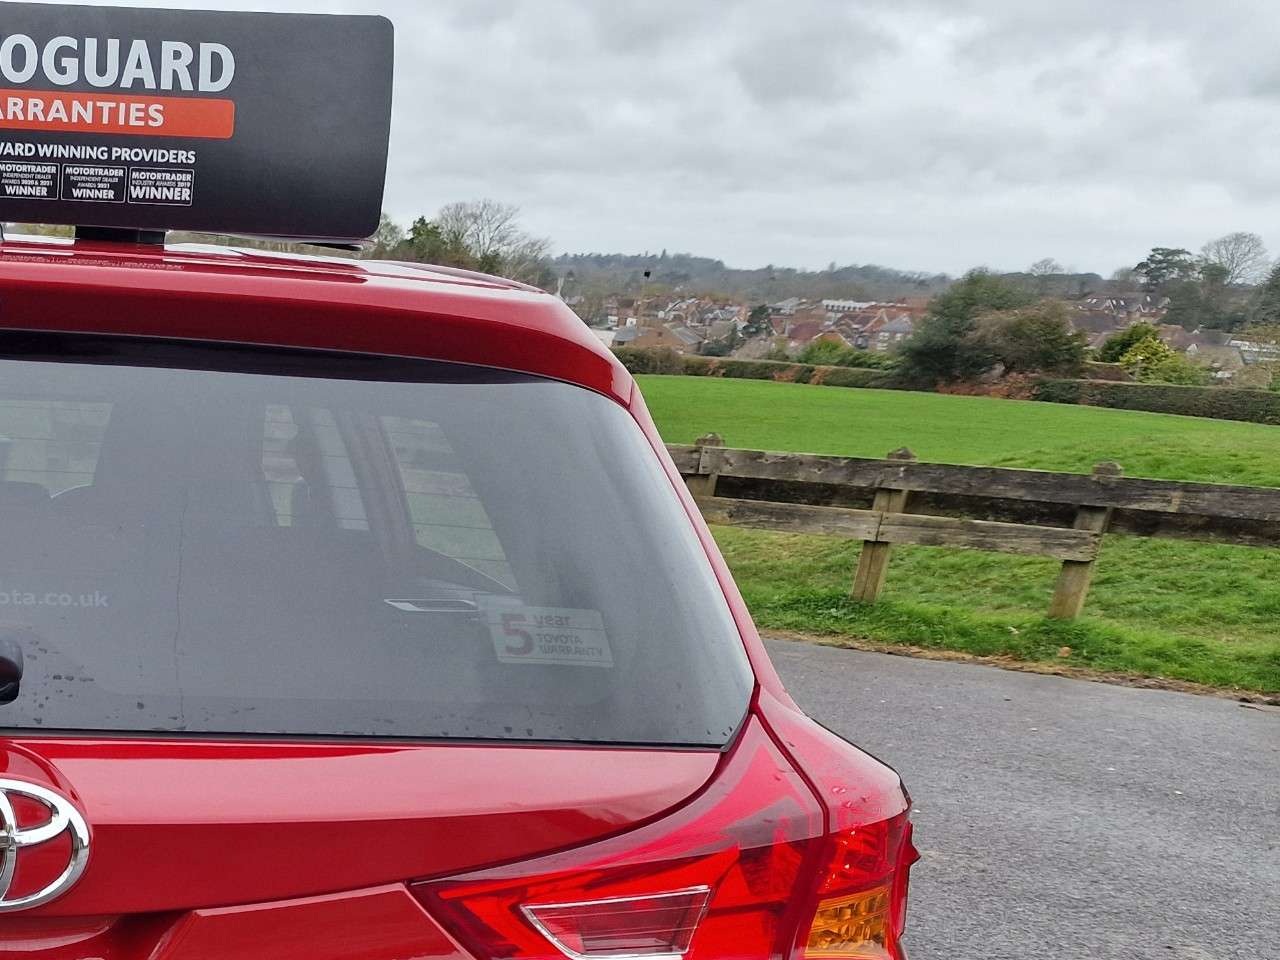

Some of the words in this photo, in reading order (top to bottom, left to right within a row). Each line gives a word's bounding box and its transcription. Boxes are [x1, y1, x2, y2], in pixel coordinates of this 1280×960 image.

[36, 144, 108, 161] WINNING
[111, 147, 197, 164] PROVIDERS
[65, 166, 124, 177] MOTORTRADER
[131, 171, 192, 182] MOTORTRADER
[4, 184, 48, 197] WINNER
[72, 187, 115, 199] WINNER
[130, 186, 191, 201] WINNER
[500, 613, 535, 656] 5
[535, 632, 584, 645] TOYOTA
